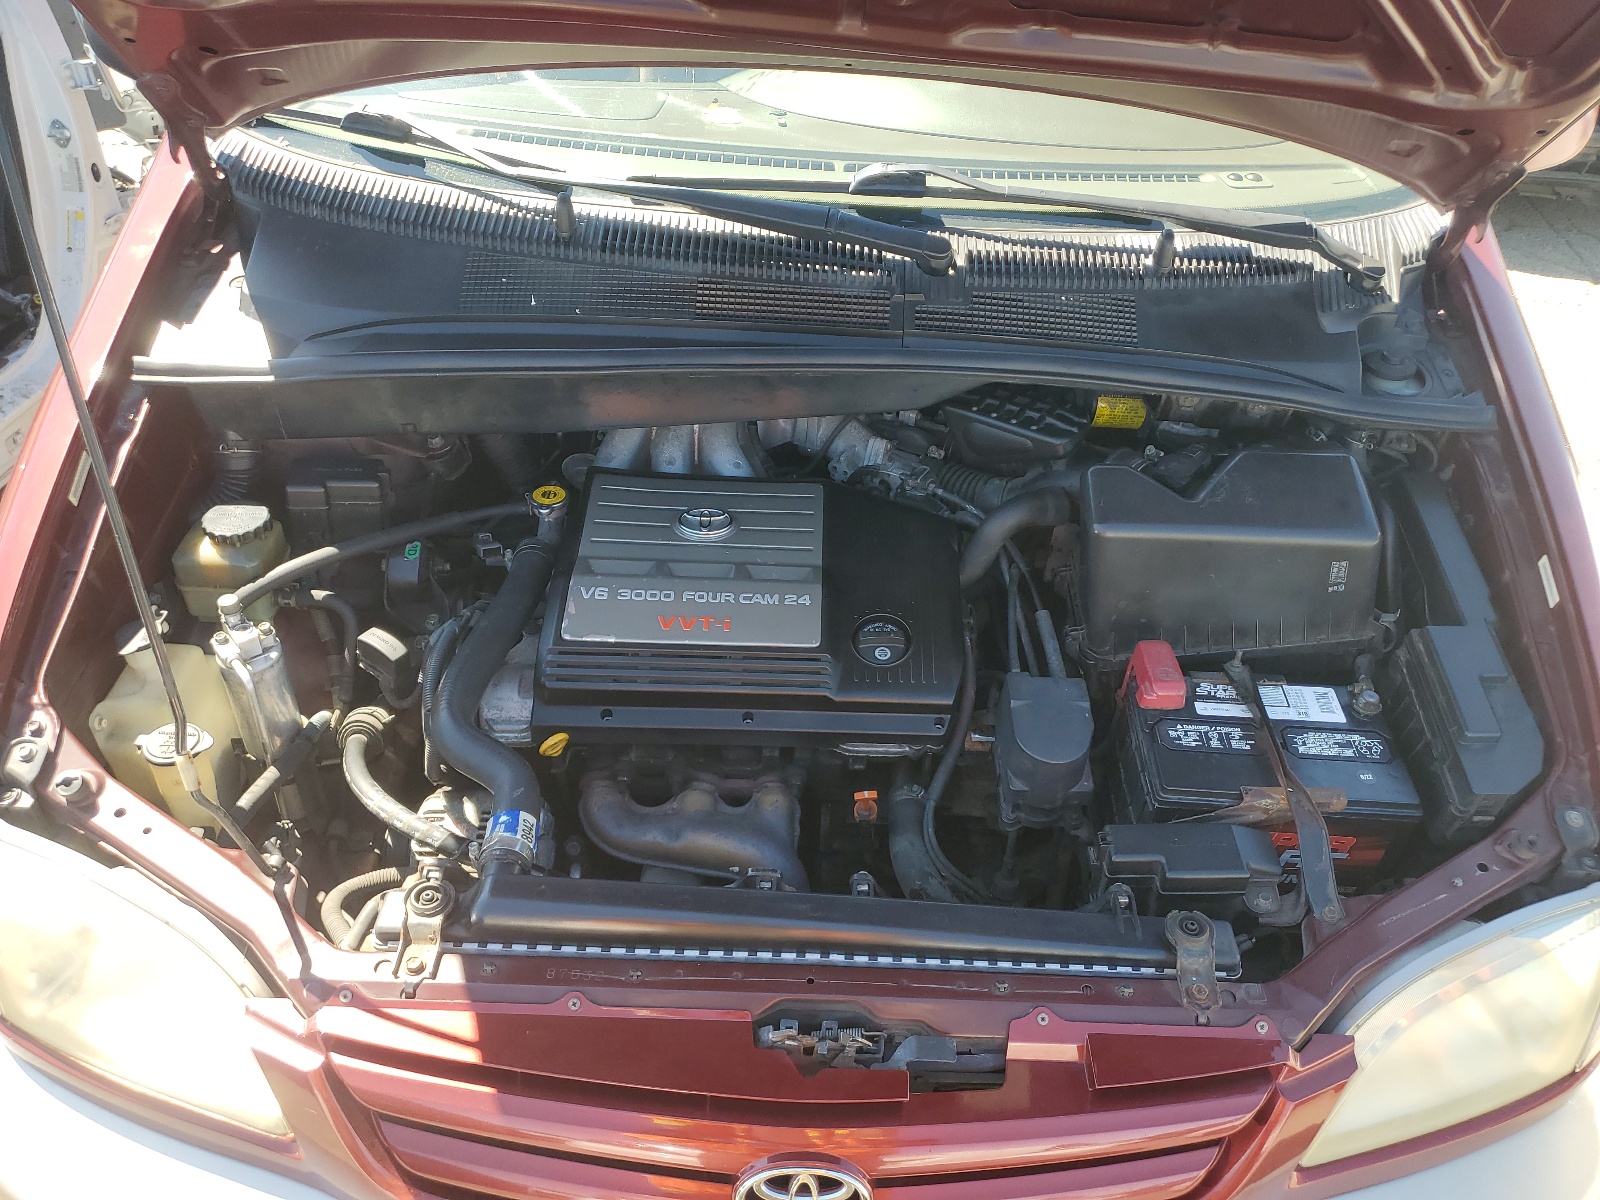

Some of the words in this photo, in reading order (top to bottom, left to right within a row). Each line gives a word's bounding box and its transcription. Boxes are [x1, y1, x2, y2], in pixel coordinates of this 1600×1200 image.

[580, 586, 609, 600] V6
[617, 588, 675, 602] 3000
[682, 590, 735, 604] FOUR
[738, 592, 780, 605] CAM
[784, 594, 812, 606] 24
[657, 614, 731, 632] VVT-i
[1195, 687, 1238, 696] STAR
[1200, 682, 1236, 691] SUPE
[520, 818, 534, 844] 8942
